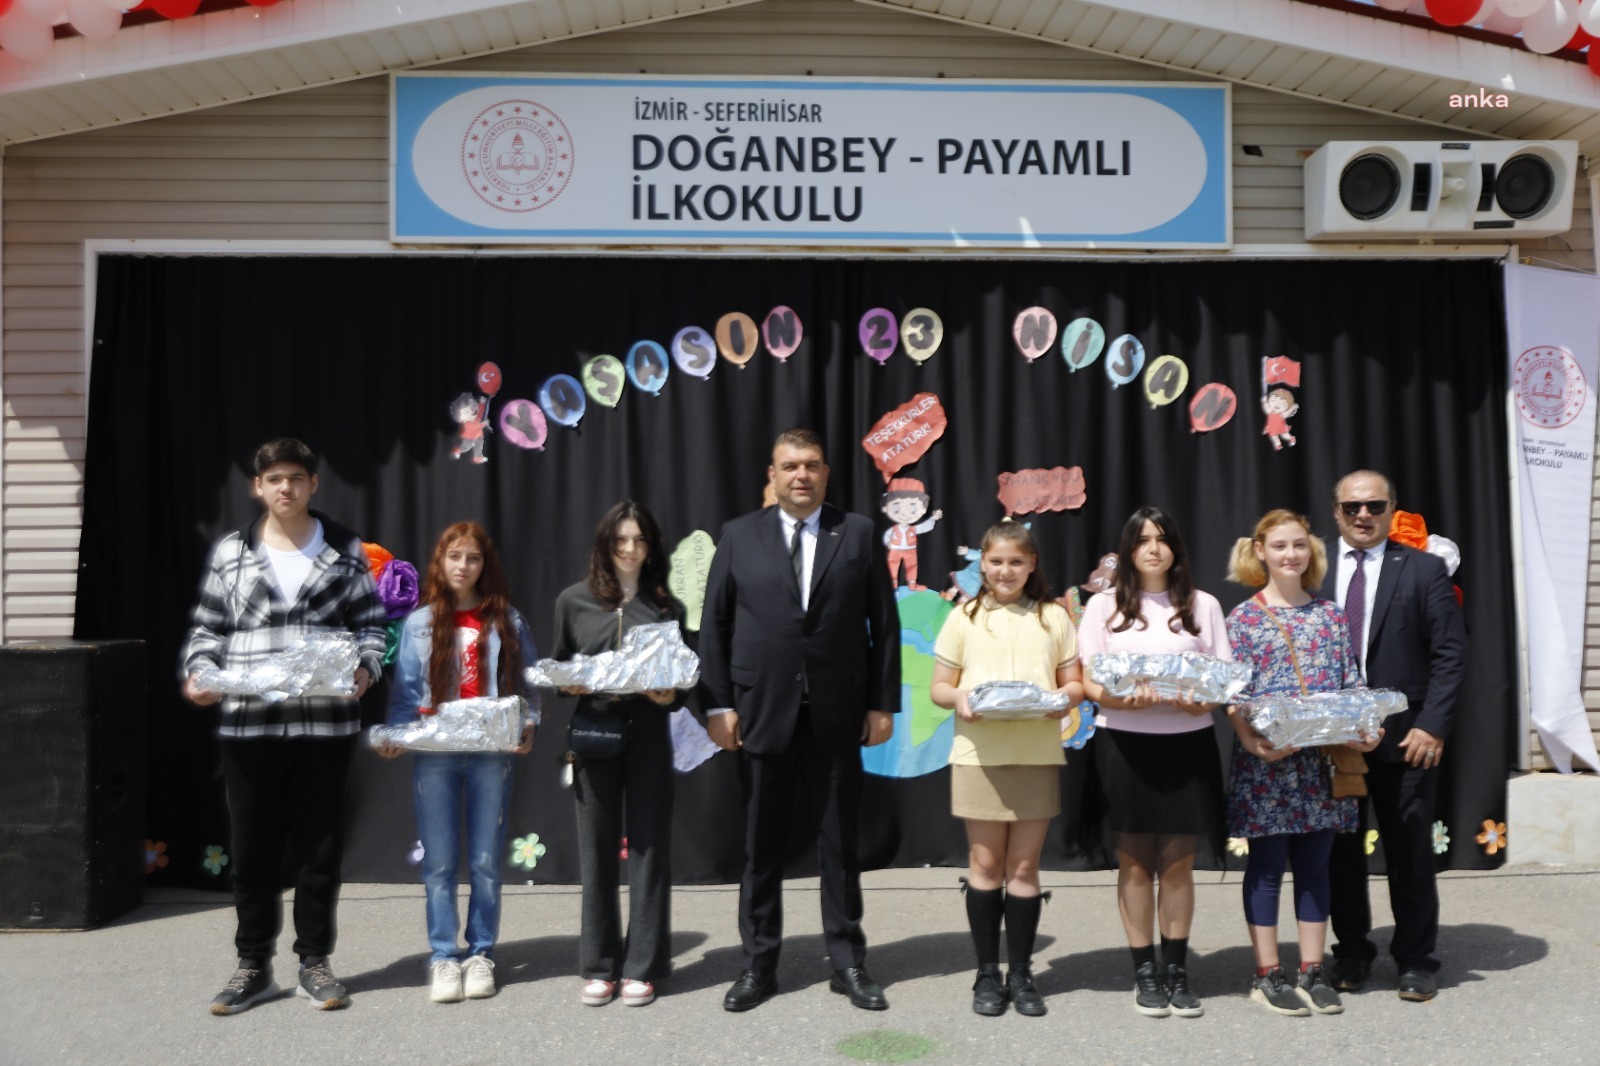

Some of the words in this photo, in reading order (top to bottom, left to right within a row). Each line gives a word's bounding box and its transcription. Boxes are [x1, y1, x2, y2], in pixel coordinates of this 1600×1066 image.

[635, 96, 688, 122] İZMİR
[704, 98, 822, 123] SEFERİHİSAR
[632, 126, 897, 173] DOĞANBEY
[938, 138, 1131, 176] PAYAMLI
[632, 175, 863, 222] İLKOKULU
[865, 314, 936, 350] 23
[1019, 313, 1232, 427] NİSAN
[866, 396, 938, 447] TEŞEKKÜRLER
[1554, 448, 1589, 461] PAYAMLI
